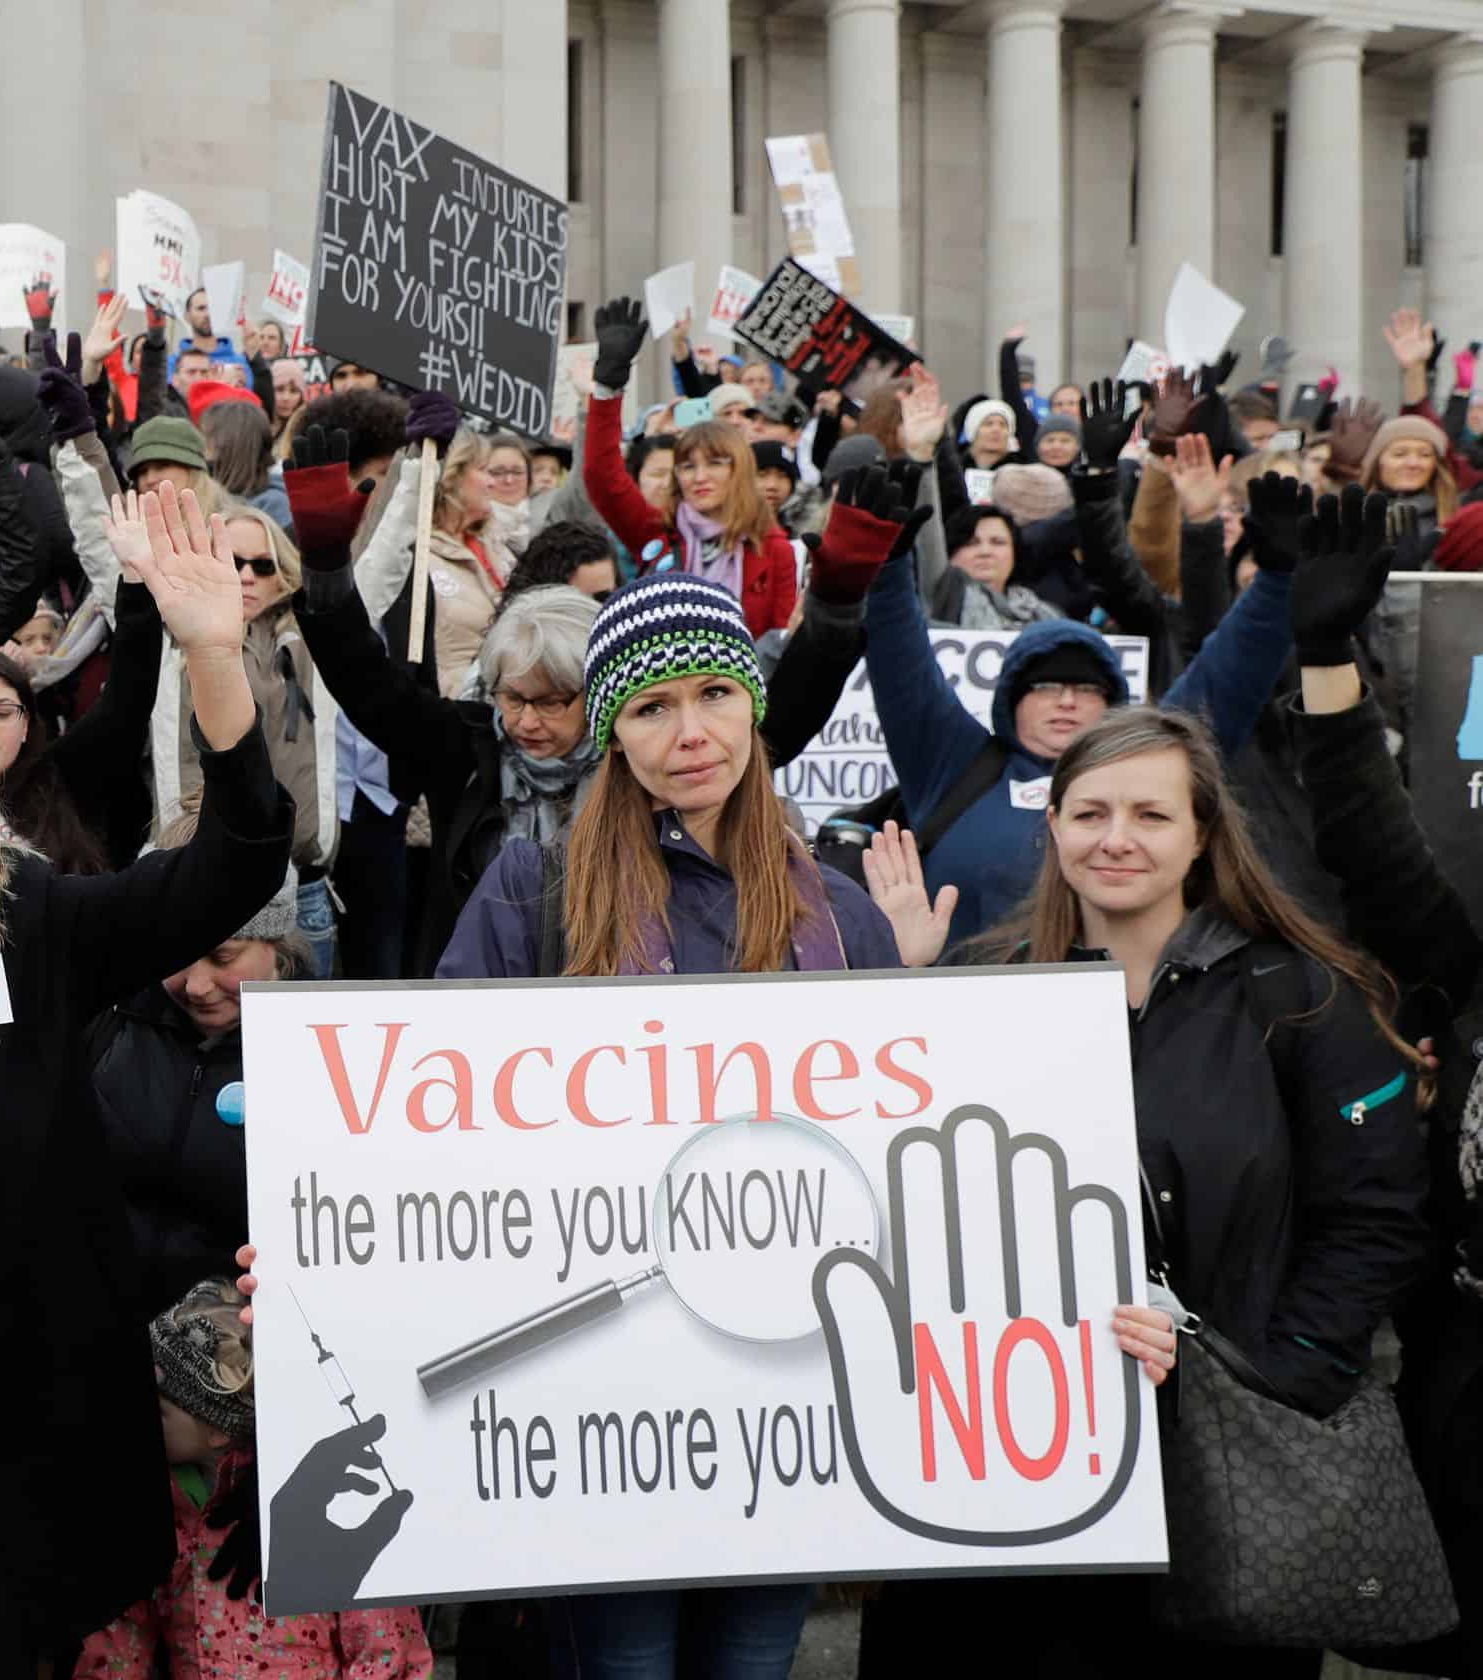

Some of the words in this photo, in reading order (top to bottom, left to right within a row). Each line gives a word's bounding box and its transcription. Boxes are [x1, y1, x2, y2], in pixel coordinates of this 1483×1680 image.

[333, 134, 417, 222] HURT
[429, 194, 478, 250] MY
[493, 221, 561, 292] KIDS
[344, 87, 437, 182] VAX
[452, 157, 569, 251] INJURIES
[319, 242, 380, 312] FOR
[321, 191, 350, 247] I
[359, 209, 407, 273] AM
[429, 238, 560, 337] FIGHTING
[419, 340, 547, 437] #WEDID
[306, 1020, 933, 1135] Vaccines
[291, 1171, 375, 1268] the
[396, 1188, 533, 1262] more
[551, 1185, 648, 1282] you
[470, 1389, 557, 1501] the
[578, 1407, 718, 1495] more
[736, 1404, 839, 1519] you
[914, 1316, 1101, 1482] NO!
